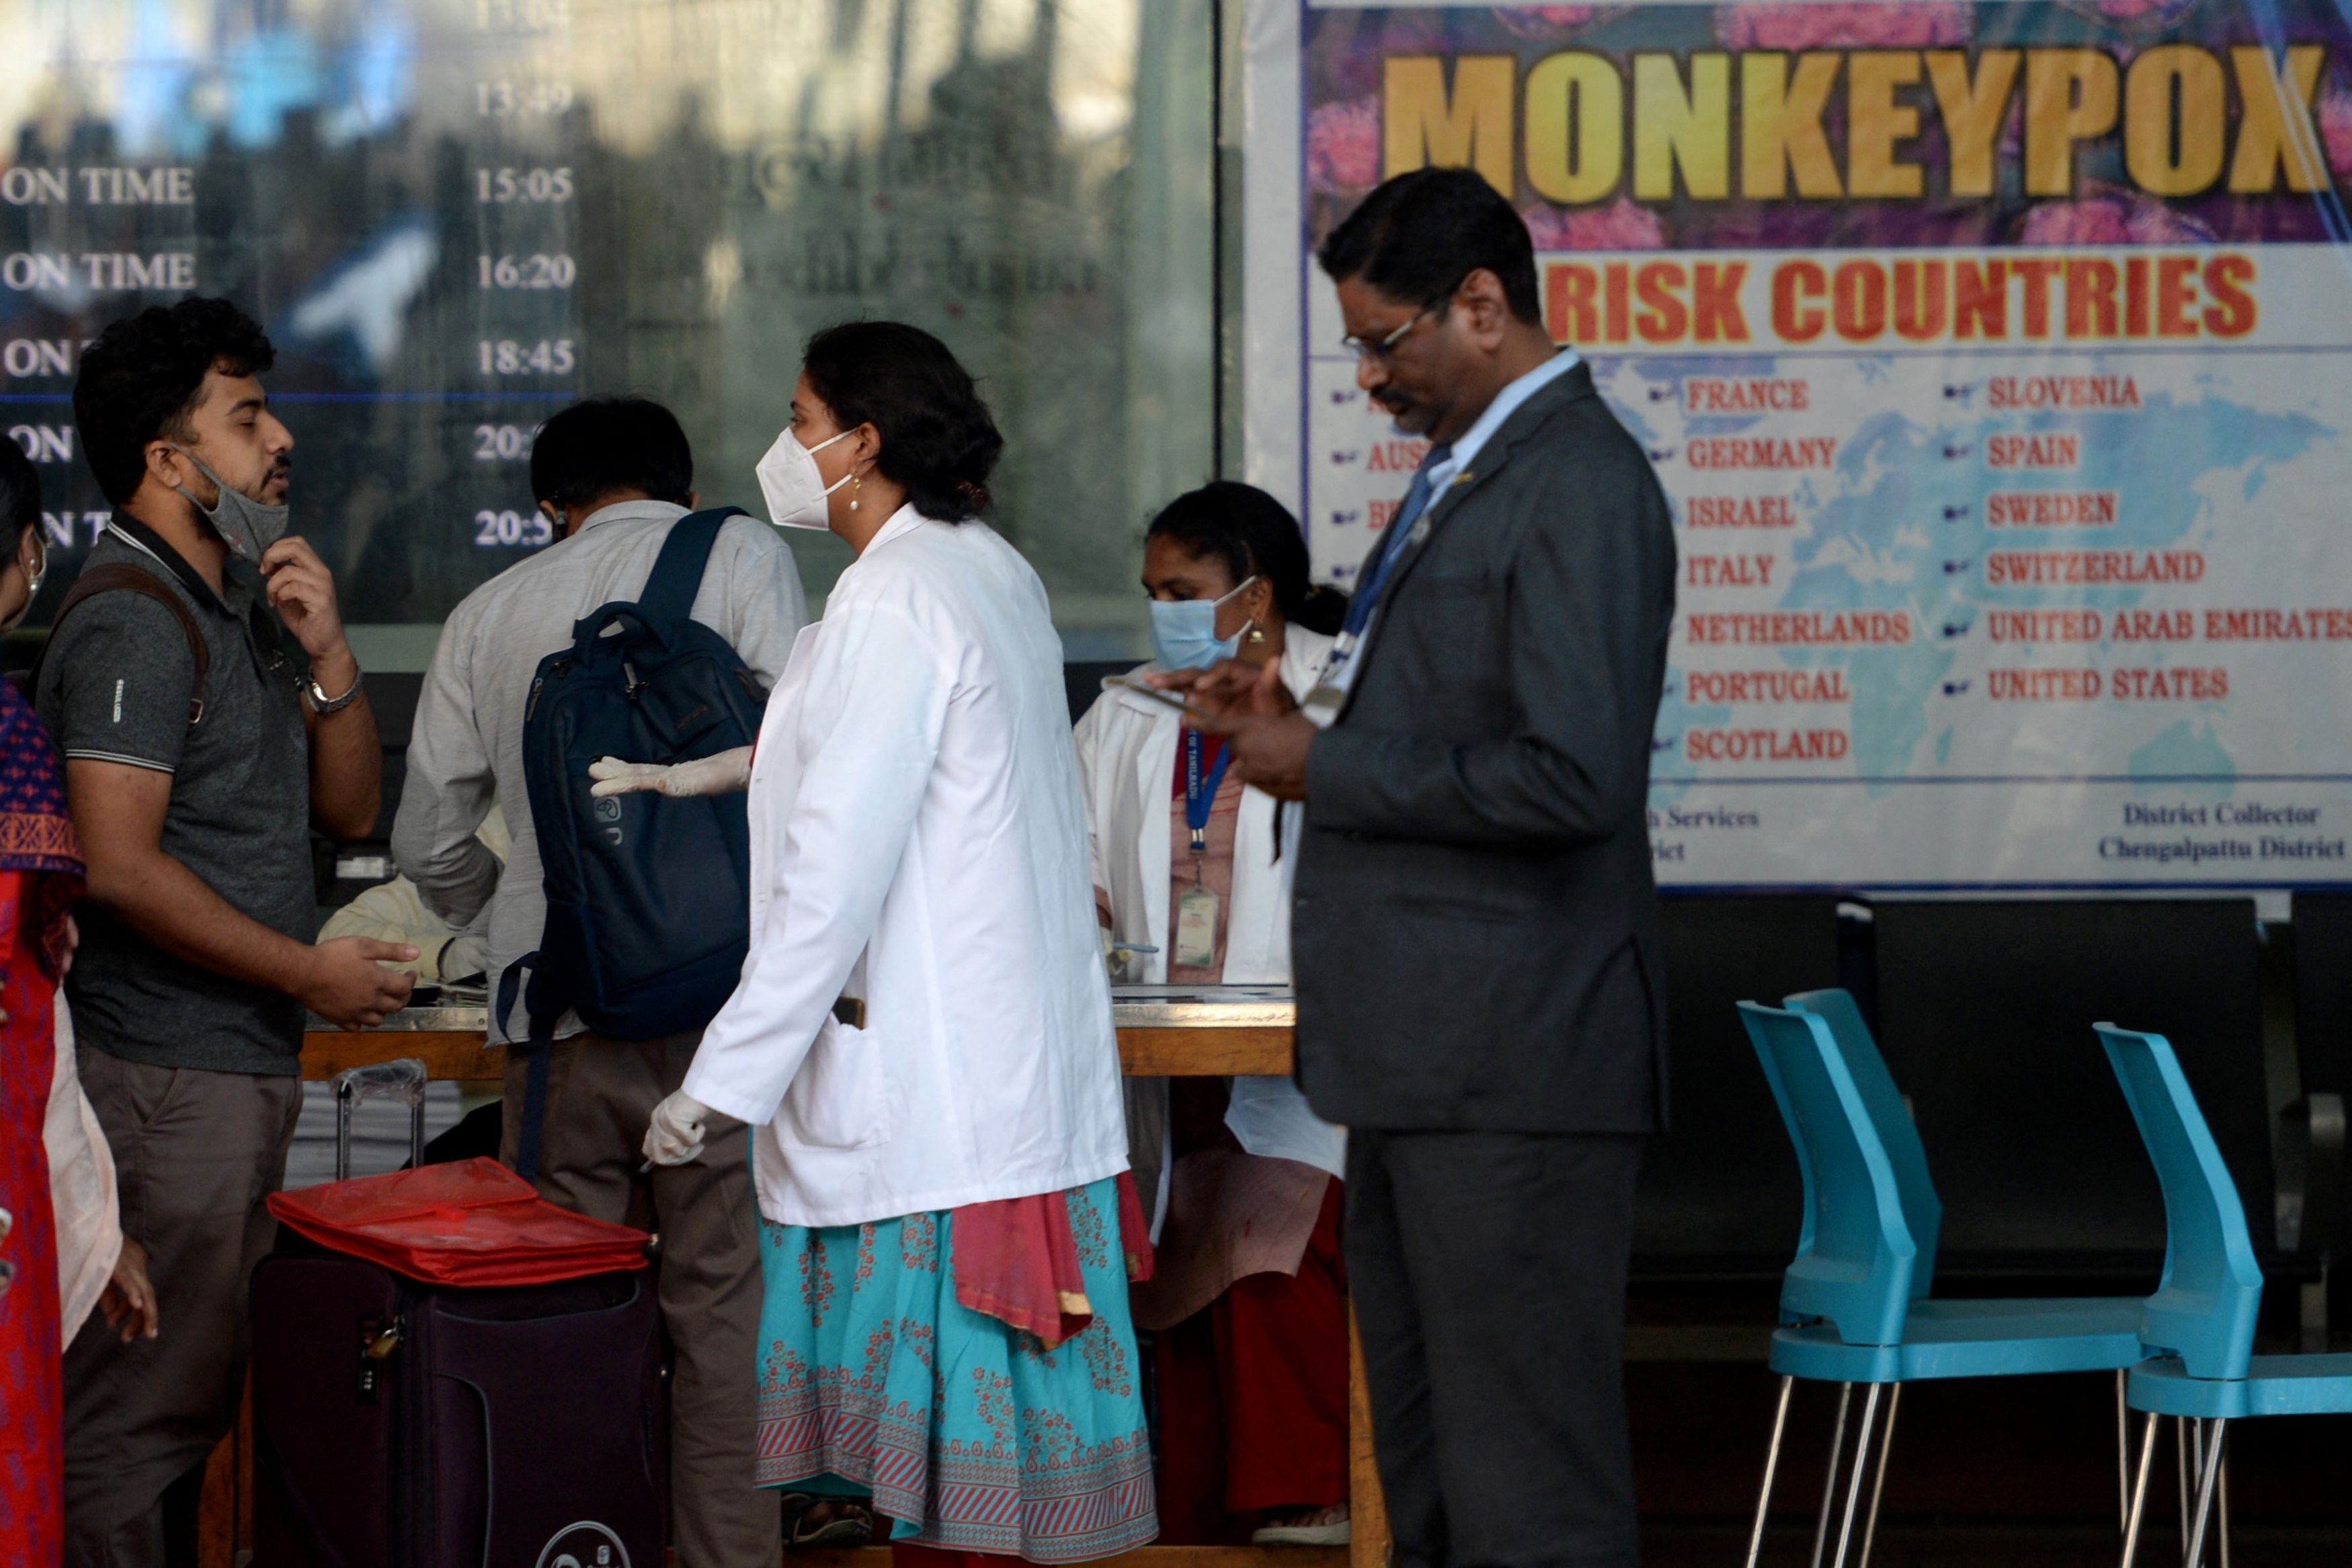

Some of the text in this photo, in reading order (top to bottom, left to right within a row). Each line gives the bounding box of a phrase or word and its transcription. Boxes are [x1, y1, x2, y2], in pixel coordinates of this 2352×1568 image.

[1381, 44, 2330, 204] MONKEYPOX
[2, 167, 195, 205] ON TIME
[476, 167, 573, 202] 15:05
[3, 252, 196, 291] ON TIME
[477, 253, 575, 290] 16:20
[1546, 253, 2258, 345] RISK COUNTRIES
[4, 339, 73, 378] ON
[479, 339, 575, 375] 18:45
[1687, 378, 1810, 411] FRANCE
[1988, 376, 2140, 409] SLOVENIA
[1687, 437, 1836, 469] GERMANY
[1988, 436, 2077, 467] SPAIN
[1687, 495, 1794, 529] ISRAEL
[1988, 492, 2116, 526] SWEDEN
[475, 509, 553, 546] 20:5
[1687, 554, 1773, 586] ITALY
[1988, 551, 2205, 585] SWITZERLAND
[1687, 610, 1912, 643] NETHERLANDS
[1988, 610, 2102, 642] UNITED
[2111, 609, 2193, 641] ARAB
[1687, 671, 1850, 703] PORTUGAL
[1988, 668, 2229, 701] UNITED STATES
[1687, 729, 1849, 761] SCOTLAND
[1668, 805, 1759, 829] Services
[2123, 802, 2320, 827] District Collector
[2098, 835, 2345, 865] Chengalpattu District
